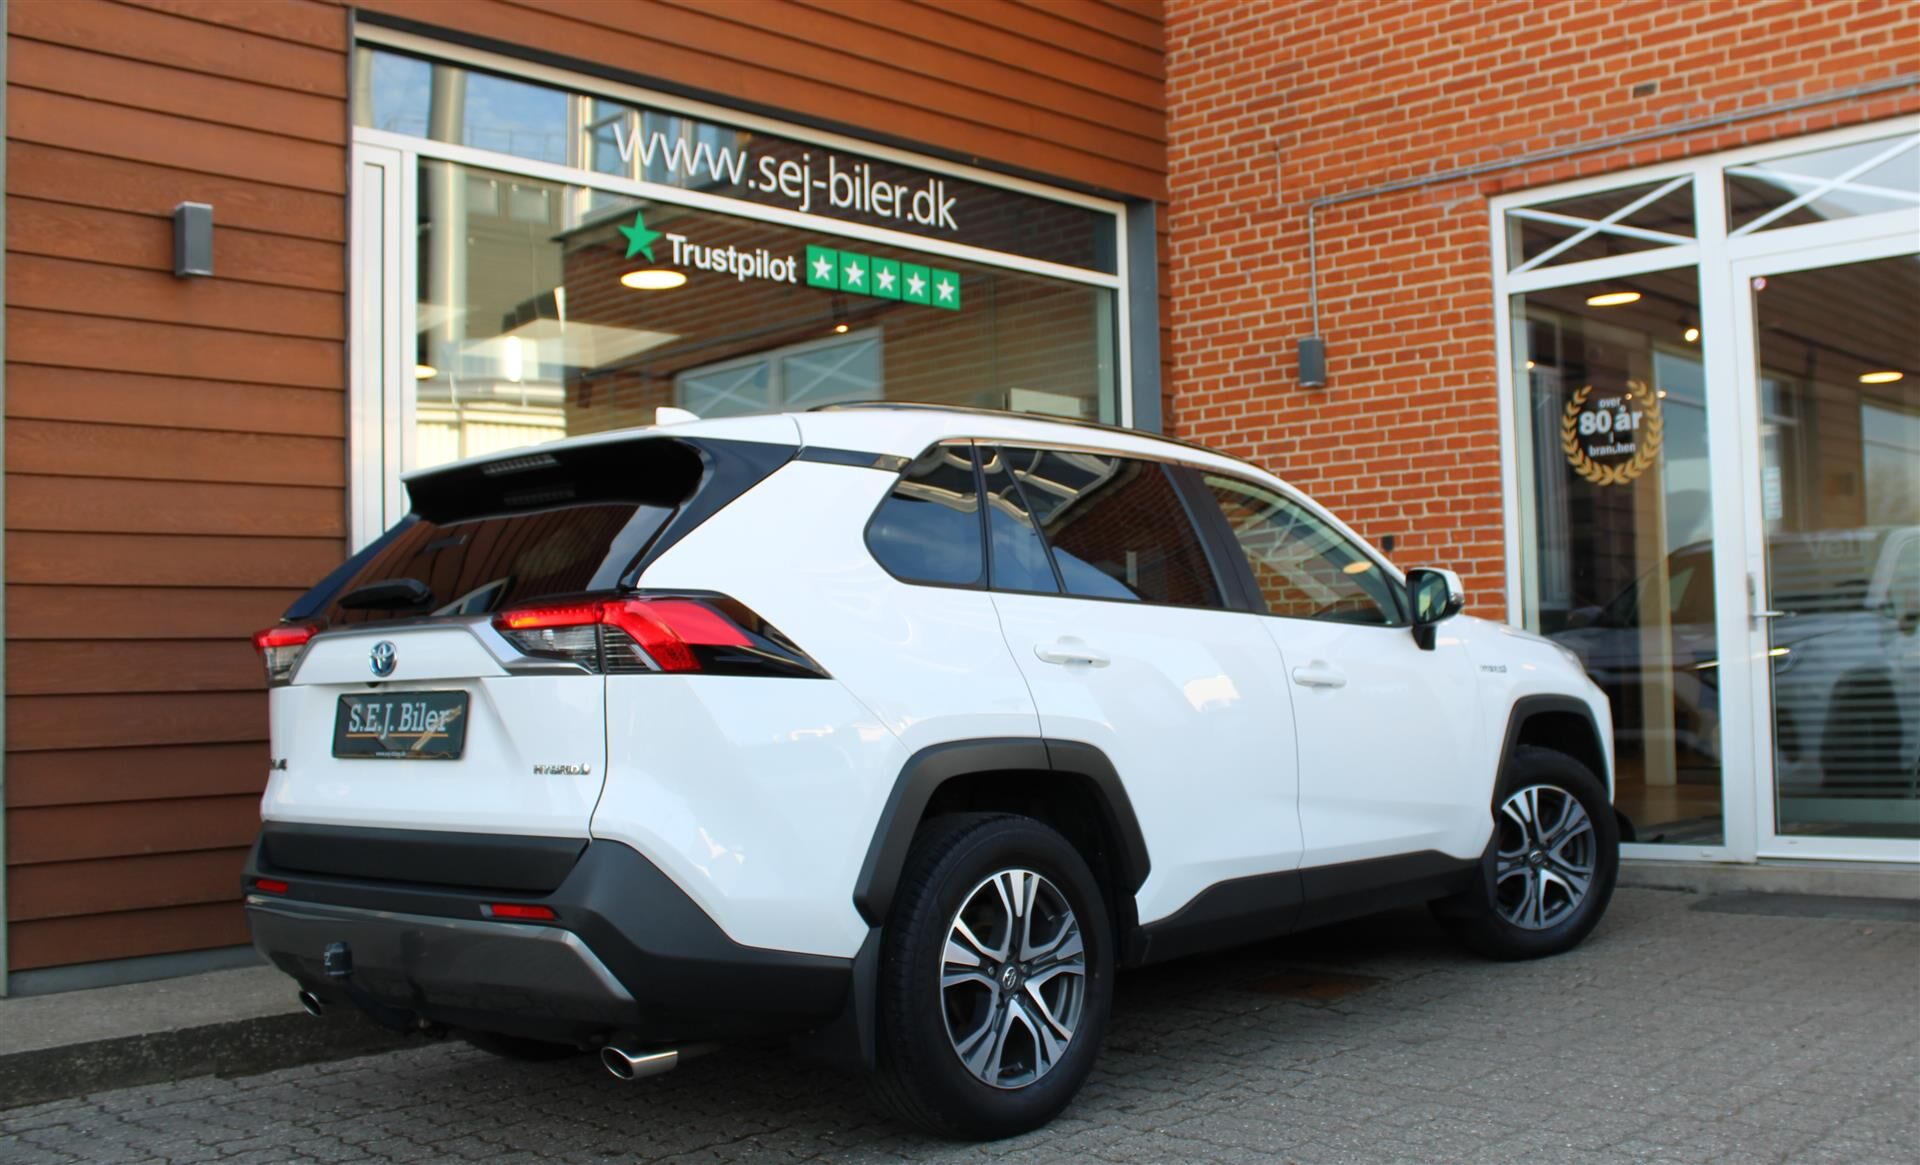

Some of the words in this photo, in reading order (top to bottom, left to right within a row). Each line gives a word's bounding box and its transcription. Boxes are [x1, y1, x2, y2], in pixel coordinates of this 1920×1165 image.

[612, 122, 959, 232] www.sej-biler.dk
[665, 232, 798, 285] Trustpilot
[1580, 410, 1612, 435] 80
[1615, 405, 1642, 431] år
[1599, 398, 1622, 408] over
[348, 702, 395, 740] S.E.J.
[397, 702, 448, 733] Biler
